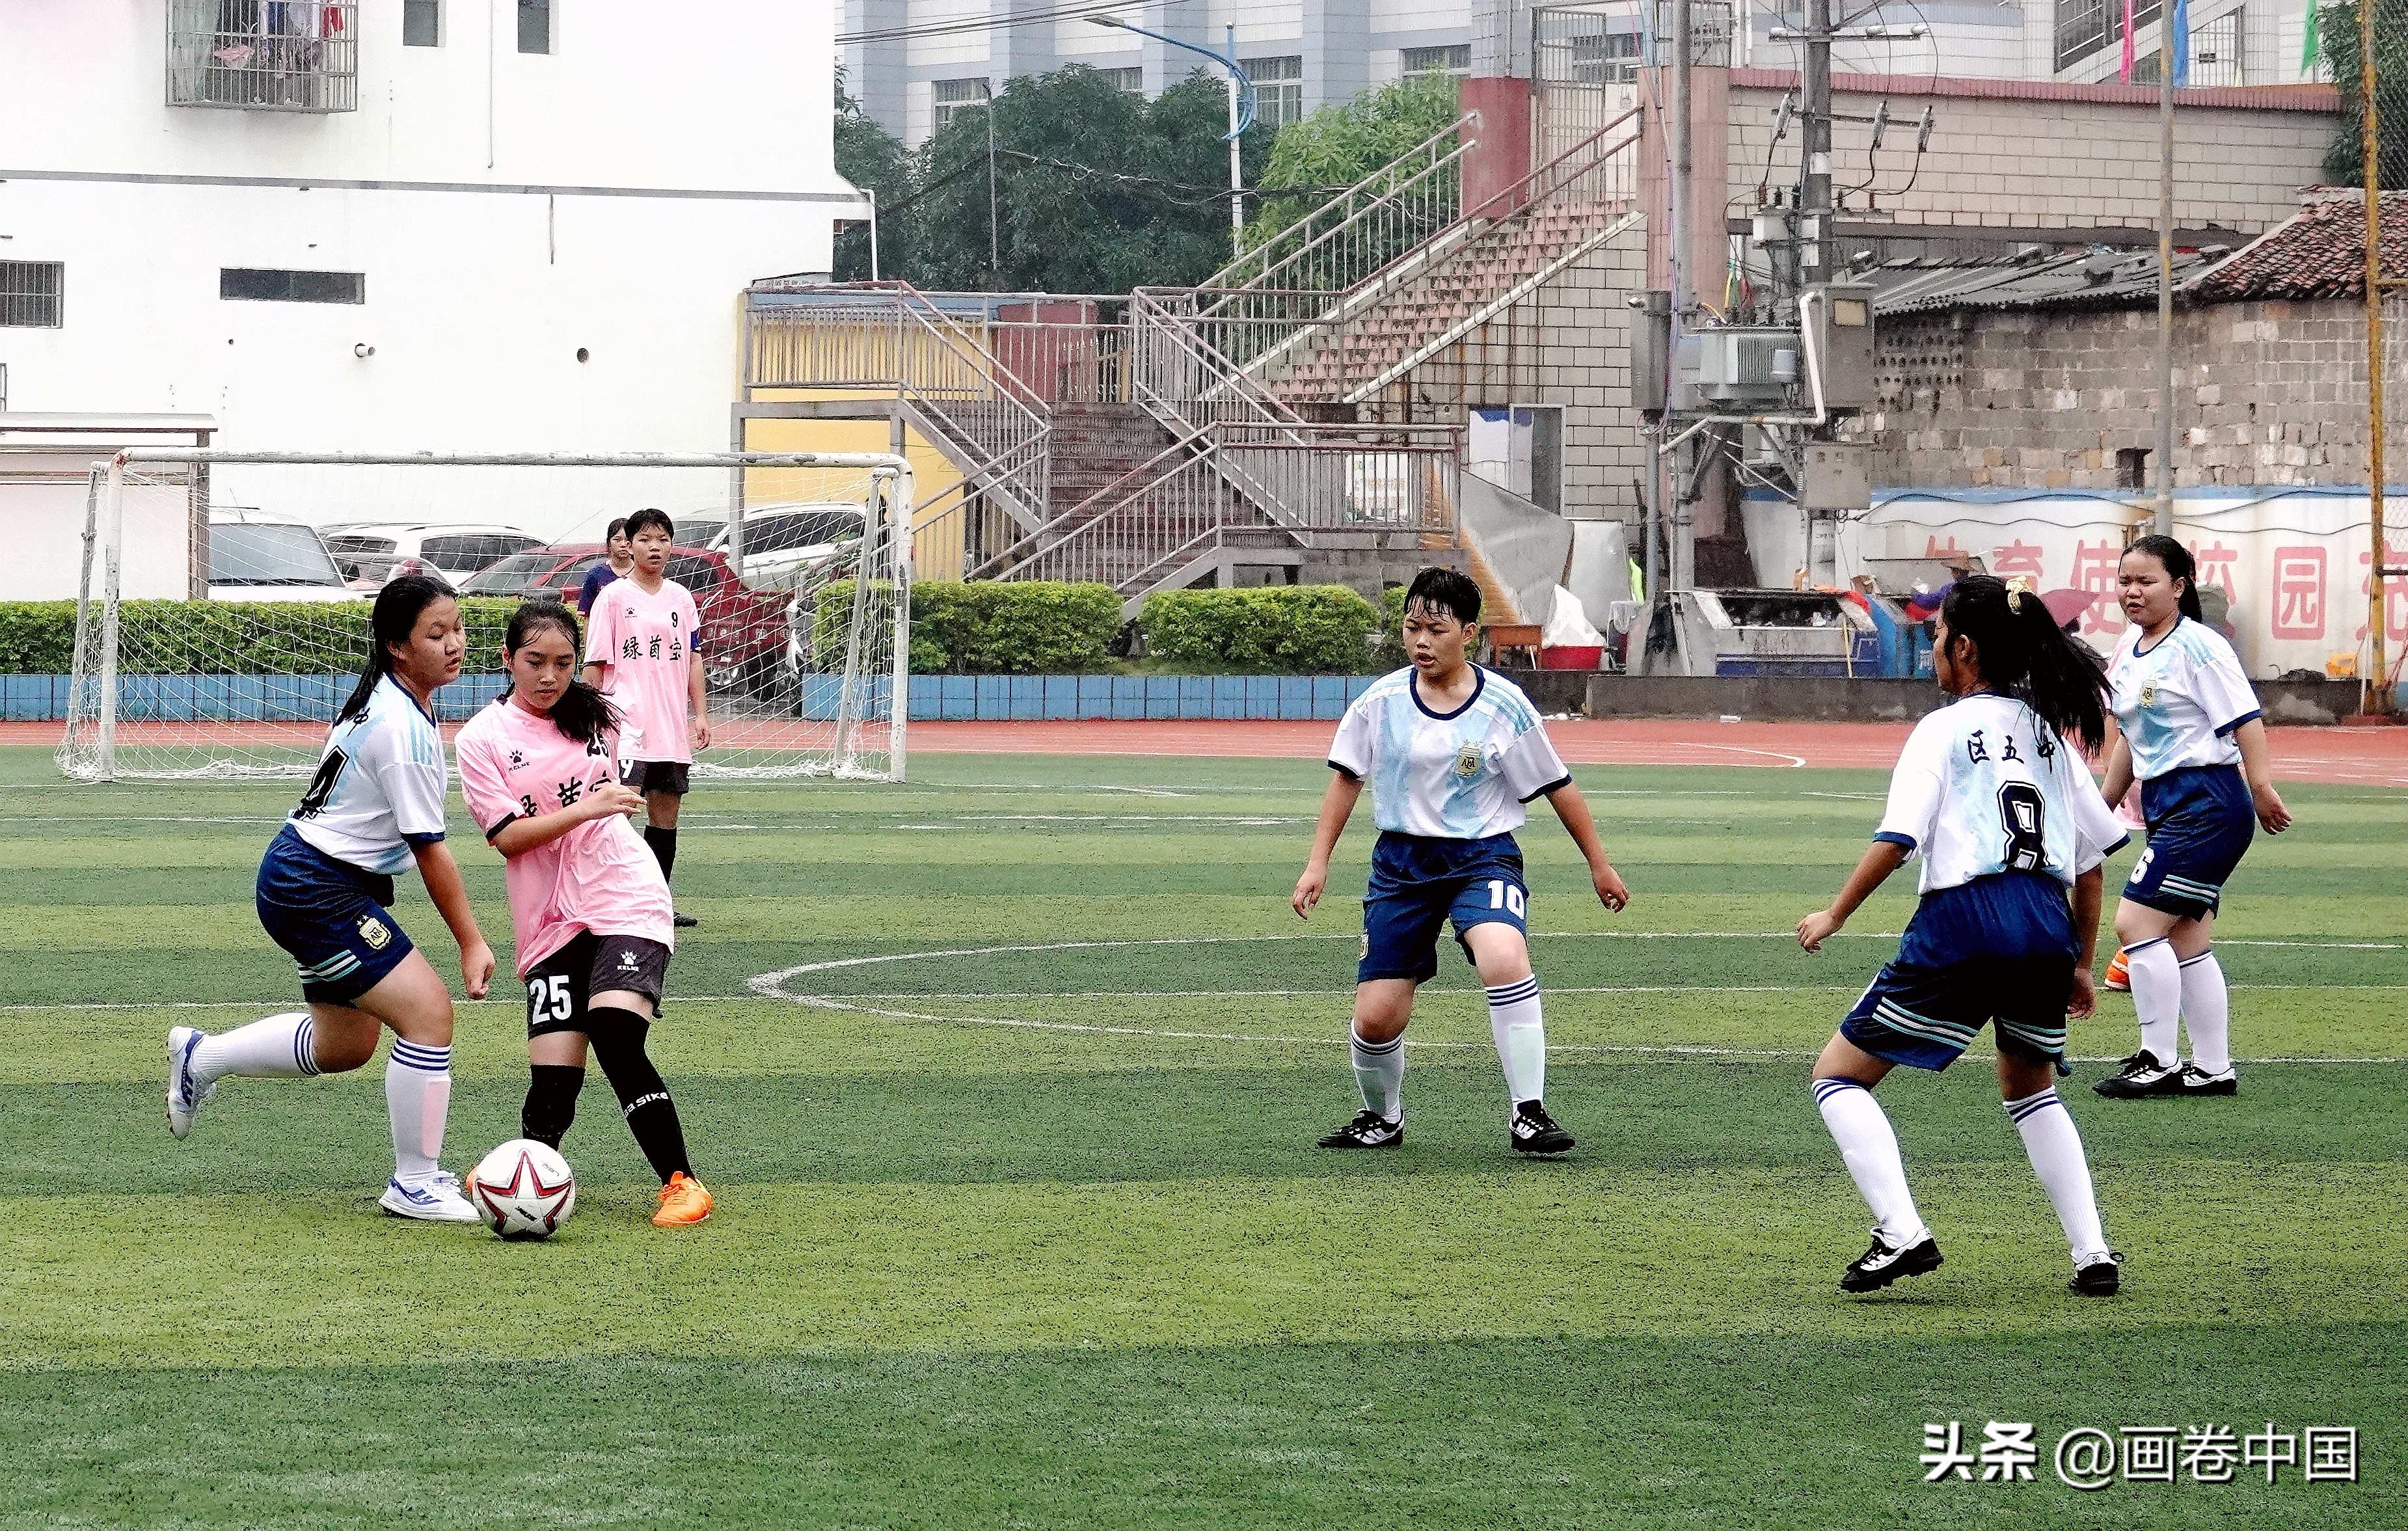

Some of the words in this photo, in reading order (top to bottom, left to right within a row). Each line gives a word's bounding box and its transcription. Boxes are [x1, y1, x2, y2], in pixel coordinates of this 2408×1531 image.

[671, 612, 679, 628] 9
[623, 634, 682, 661] 绿茵宝
[1967, 729, 2055, 775] 区五中
[1996, 780, 2051, 871] 8
[2130, 847, 2155, 884] 6
[1487, 880, 1525, 920] 10
[529, 975, 572, 1025] 25
